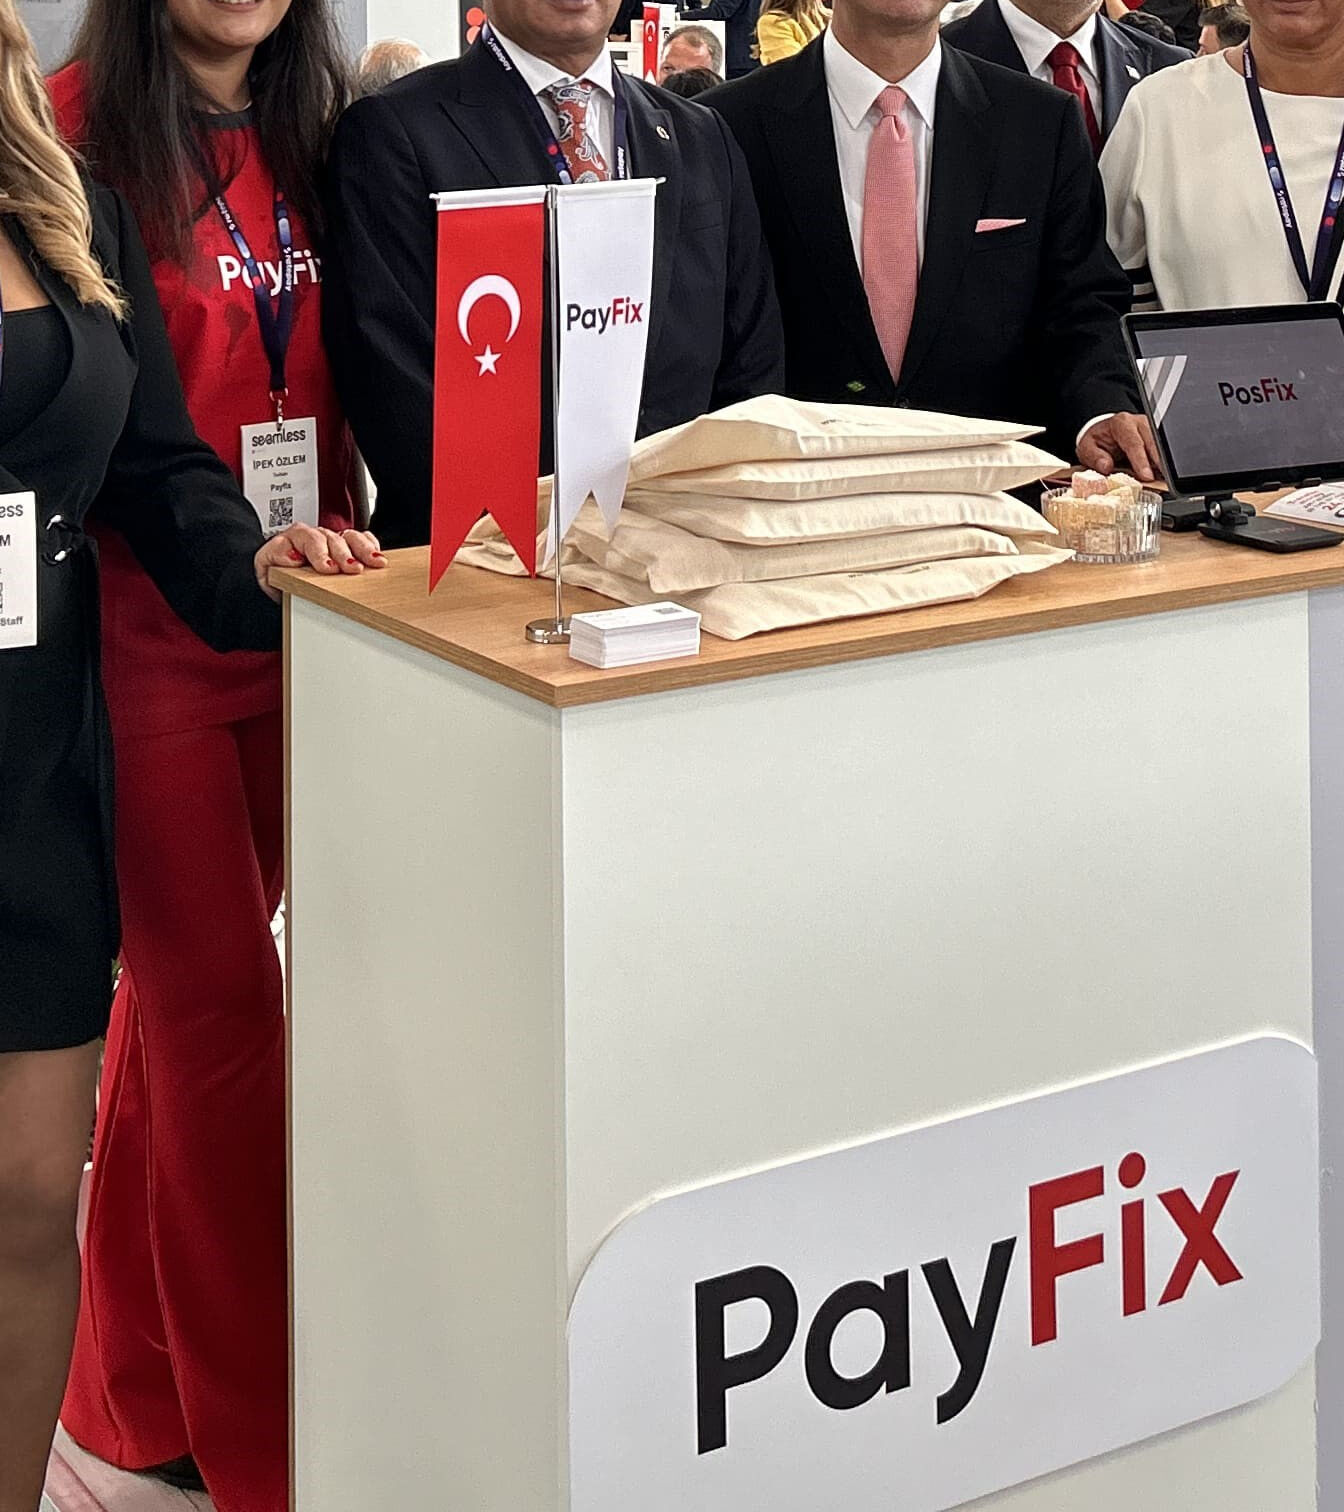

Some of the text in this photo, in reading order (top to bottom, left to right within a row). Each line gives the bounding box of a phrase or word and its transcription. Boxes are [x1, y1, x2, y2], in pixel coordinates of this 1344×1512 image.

[566, 296, 643, 334] PayFix
[1218, 378, 1298, 406] PosFix
[252, 428, 306, 447] seamless
[0, 616, 24, 627] Staff
[694, 1151, 1244, 1455] PayFix
